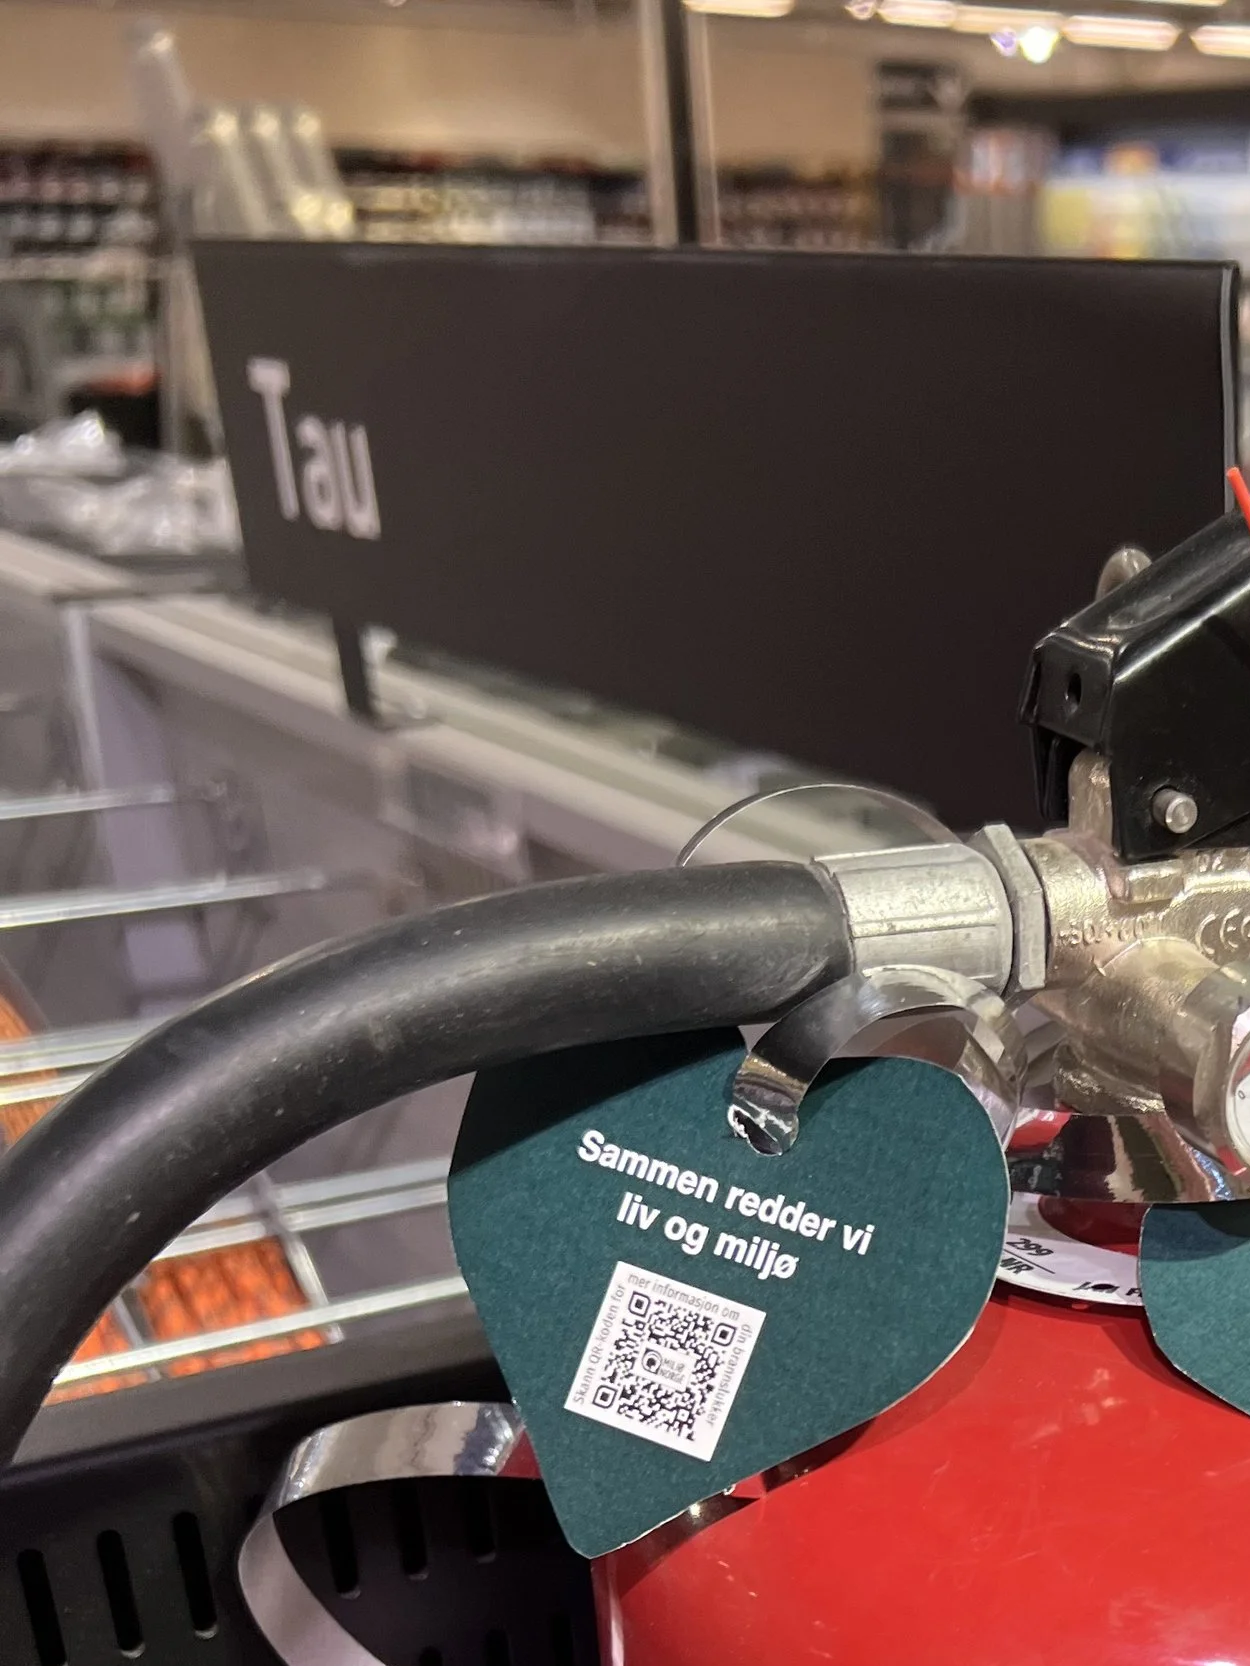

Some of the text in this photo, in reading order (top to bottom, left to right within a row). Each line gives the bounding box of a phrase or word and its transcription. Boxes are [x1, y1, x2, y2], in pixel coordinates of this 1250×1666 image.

[245, 355, 382, 541] Tau
[578, 1129, 875, 1255] Sammen redder vi
[616, 1191, 800, 1280] liv og miljø
[573, 1284, 626, 1405] Skann QR-koden for
[628, 1273, 740, 1321] mer informasjon om
[706, 1323, 753, 1427] din brannslukker
